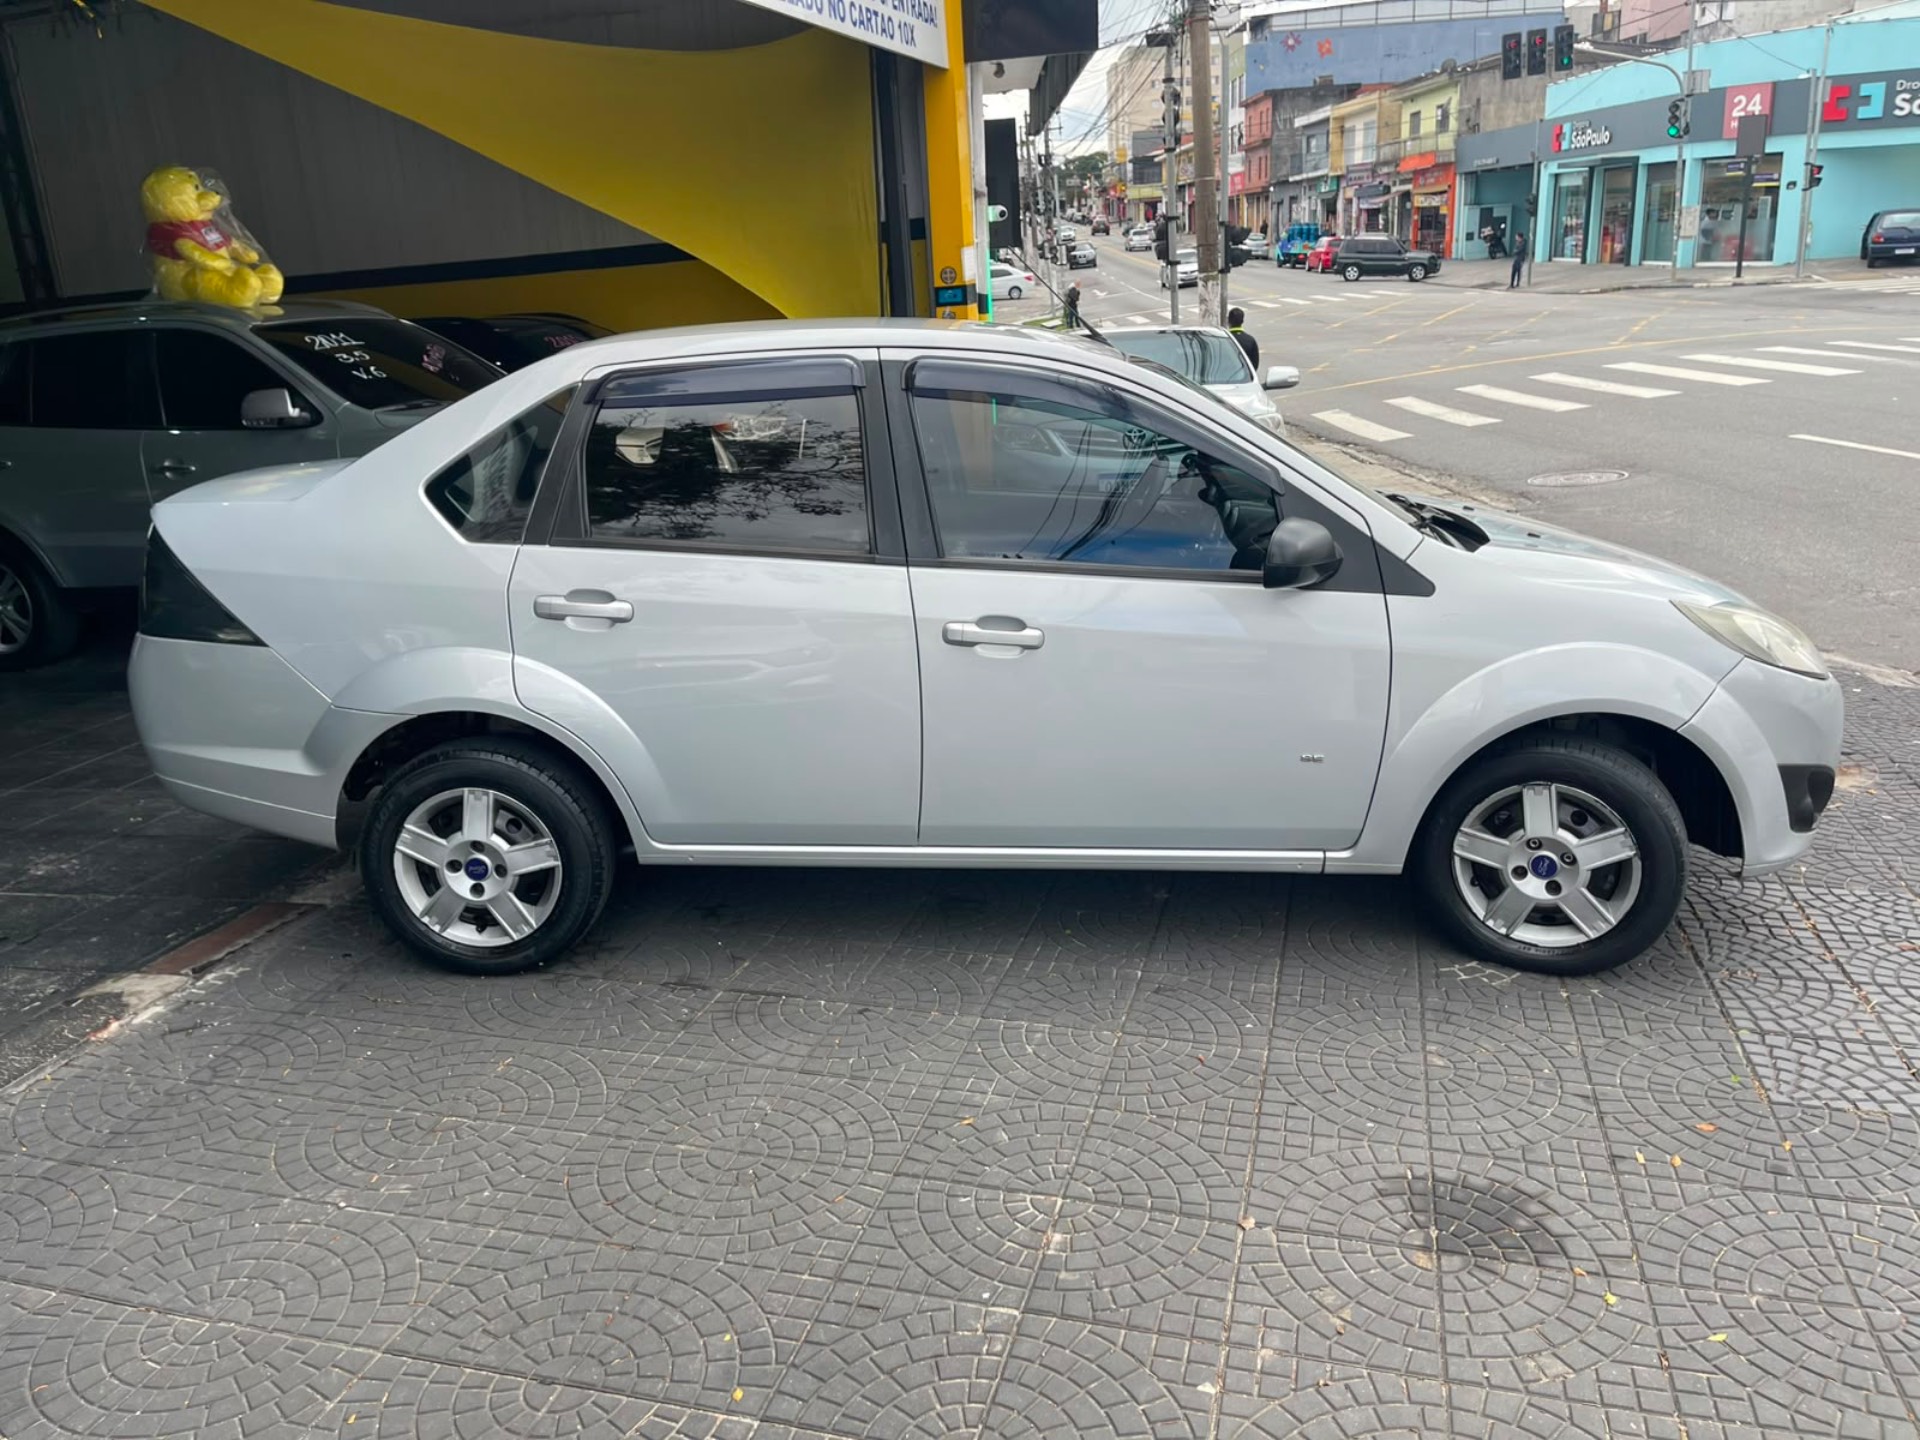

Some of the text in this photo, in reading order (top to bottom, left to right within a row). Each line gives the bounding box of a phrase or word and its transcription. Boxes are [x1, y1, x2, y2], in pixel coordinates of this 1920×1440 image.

[828, 0, 845, 23] NO
[898, 20, 917, 48] 10X
[1732, 92, 1762, 117] 24
